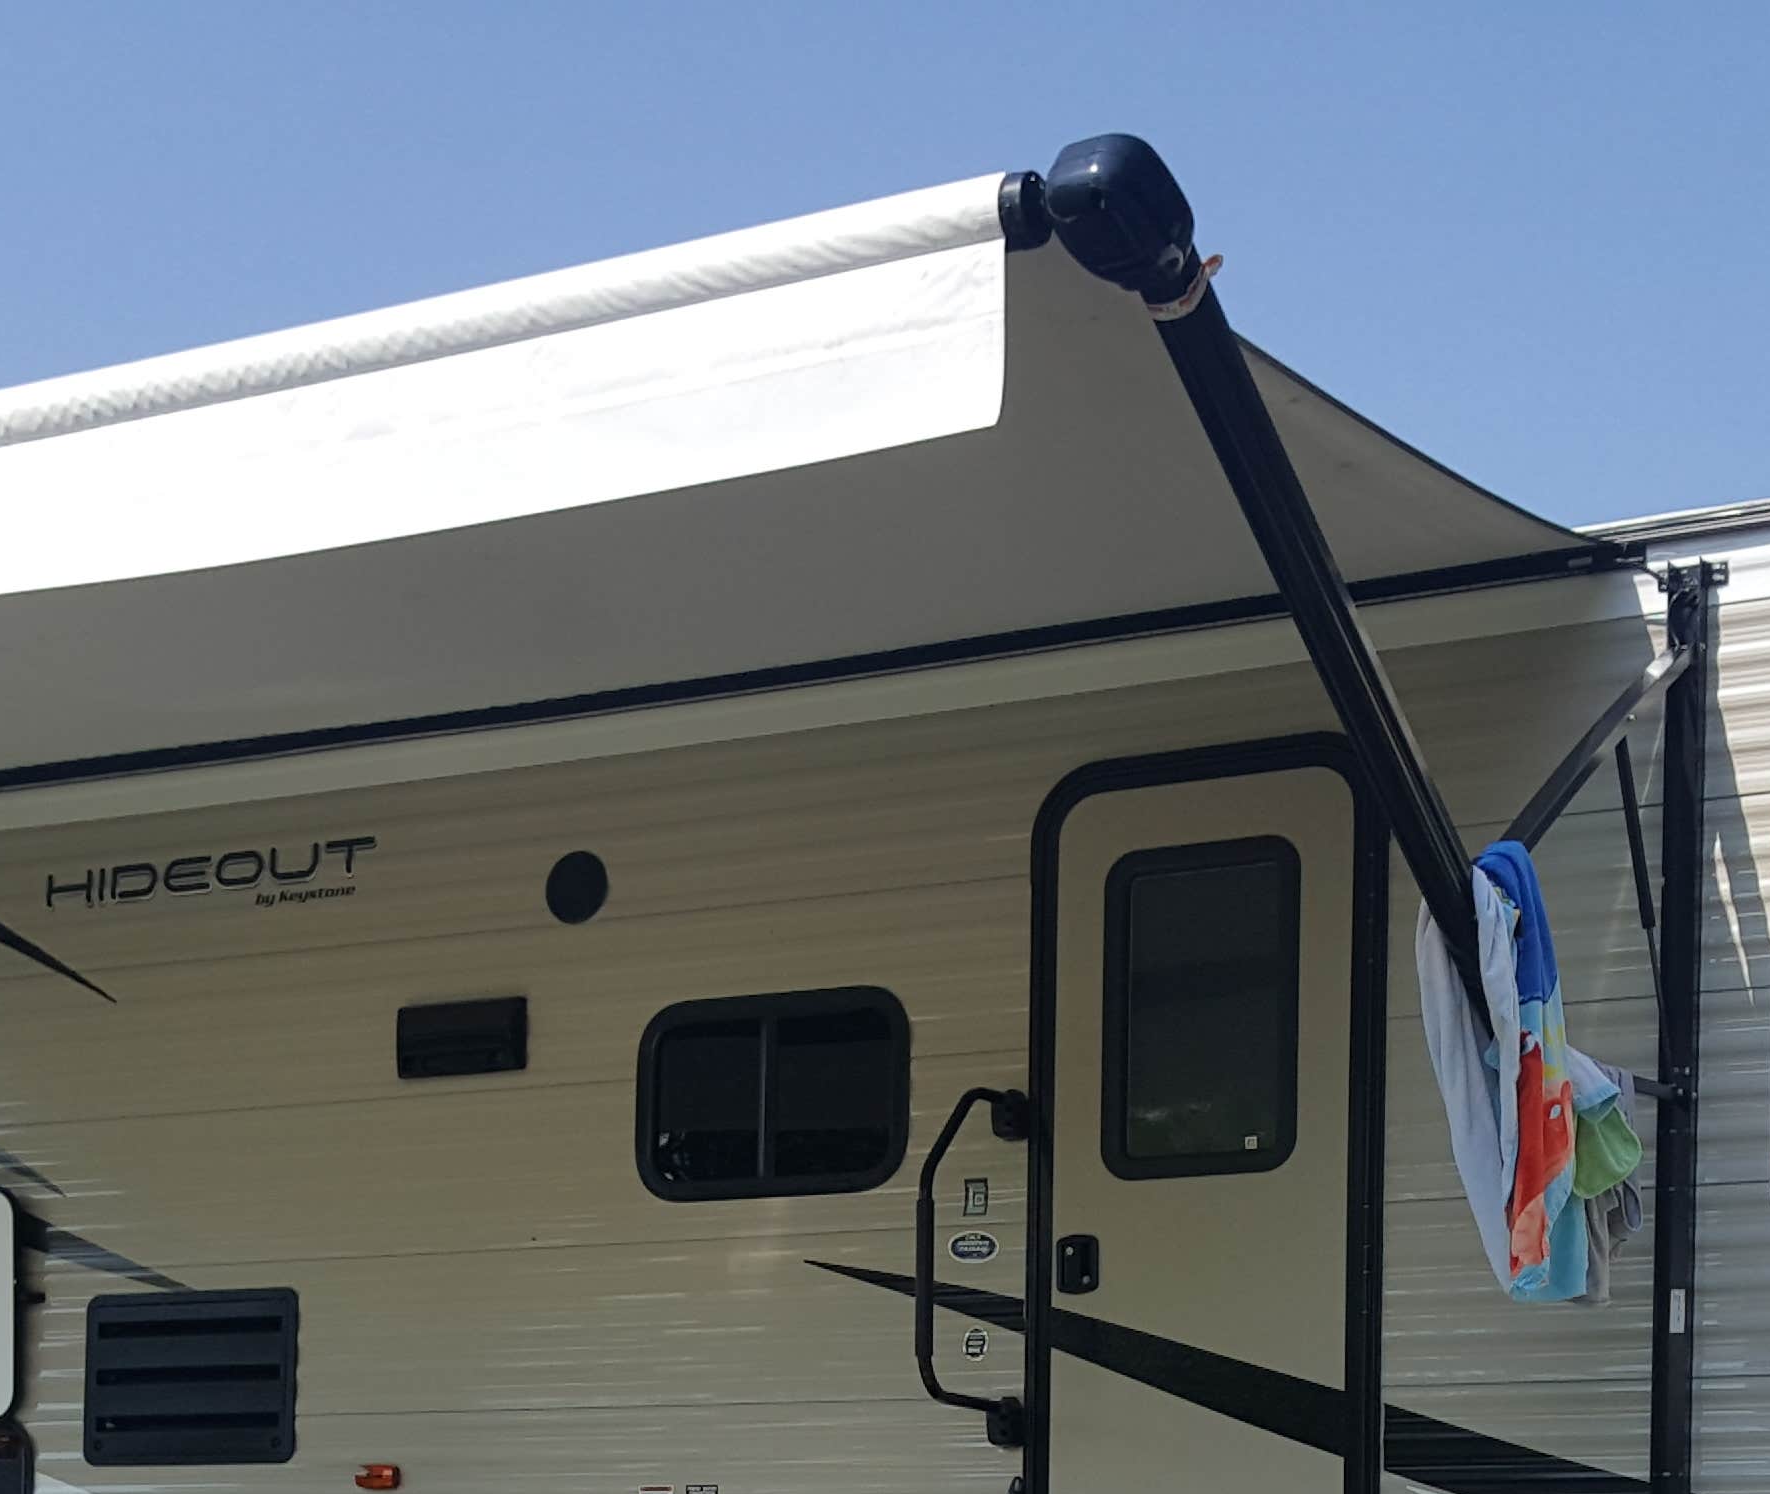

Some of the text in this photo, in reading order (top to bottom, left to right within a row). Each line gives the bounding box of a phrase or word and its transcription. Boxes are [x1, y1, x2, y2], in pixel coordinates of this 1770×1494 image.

[45, 836, 376, 908] HIDEOUT
[255, 886, 356, 908] by Keystone
